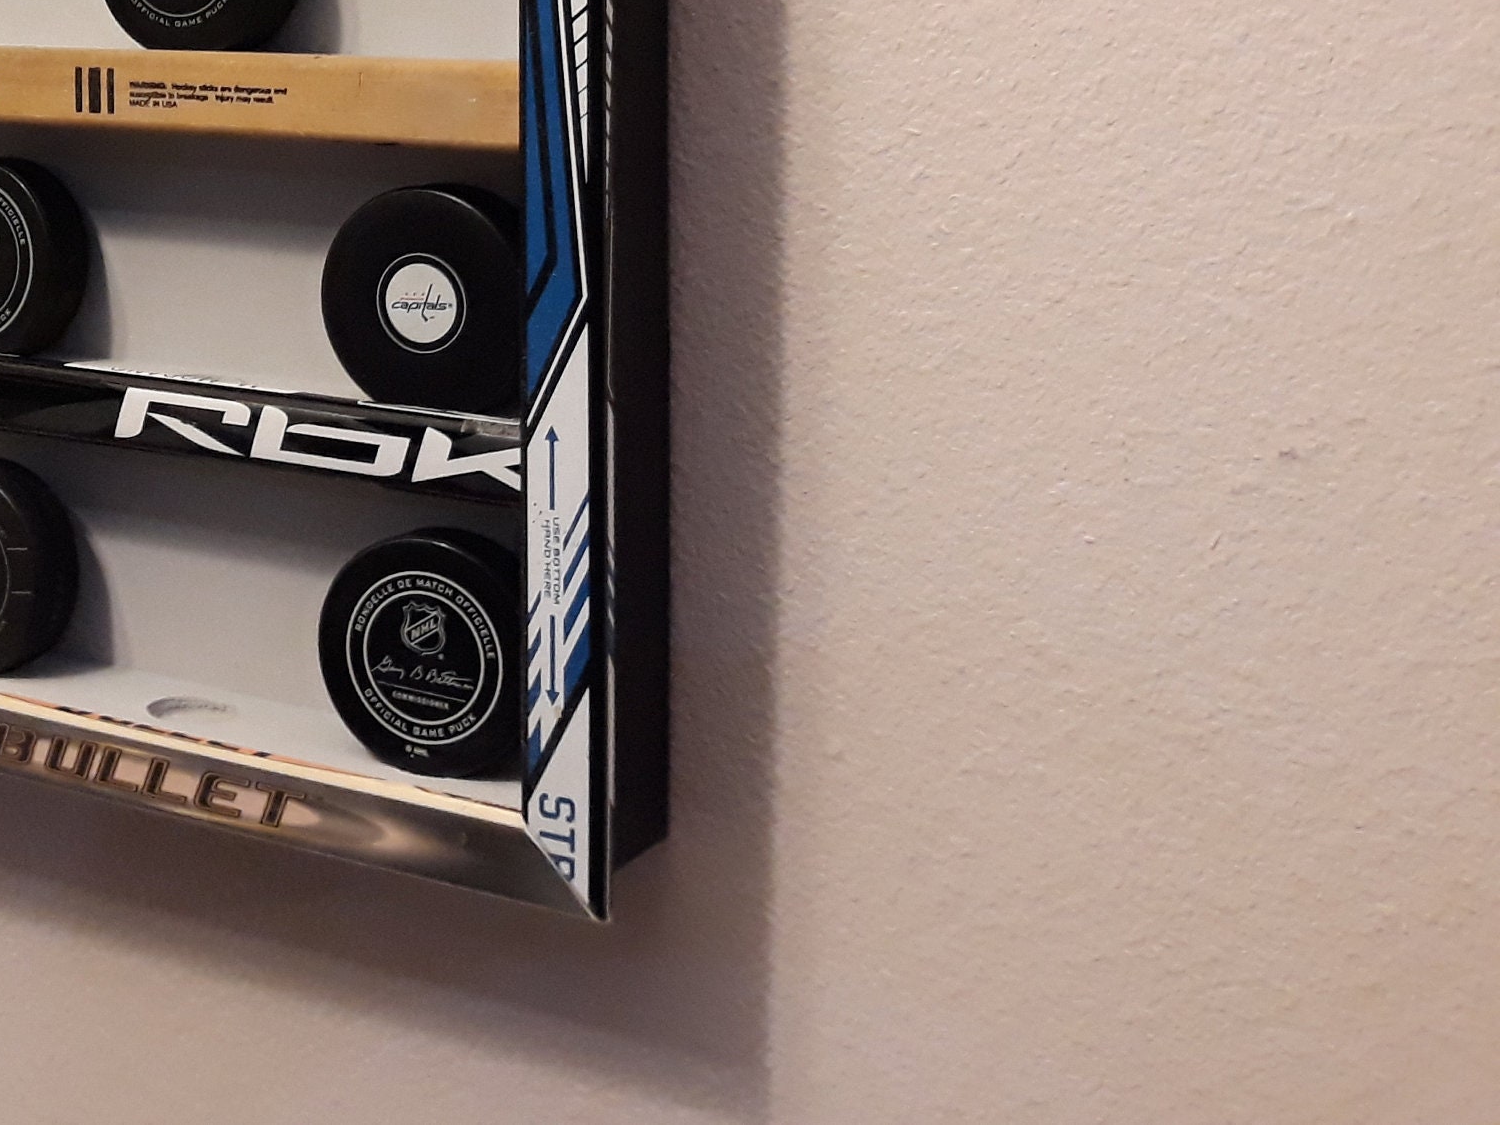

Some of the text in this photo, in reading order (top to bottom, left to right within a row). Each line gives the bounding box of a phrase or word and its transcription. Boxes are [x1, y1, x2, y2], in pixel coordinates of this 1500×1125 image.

[174, 17, 203, 28] GAME
[542, 519, 552, 598] HAND HERE
[552, 517, 561, 605] USE BOTTOM
[354, 578, 496, 659] RONDELLE DE MATCH OFFICIELLE
[410, 617, 438, 641] NHL
[363, 687, 477, 737] OFFICIAL GAME PUCK
